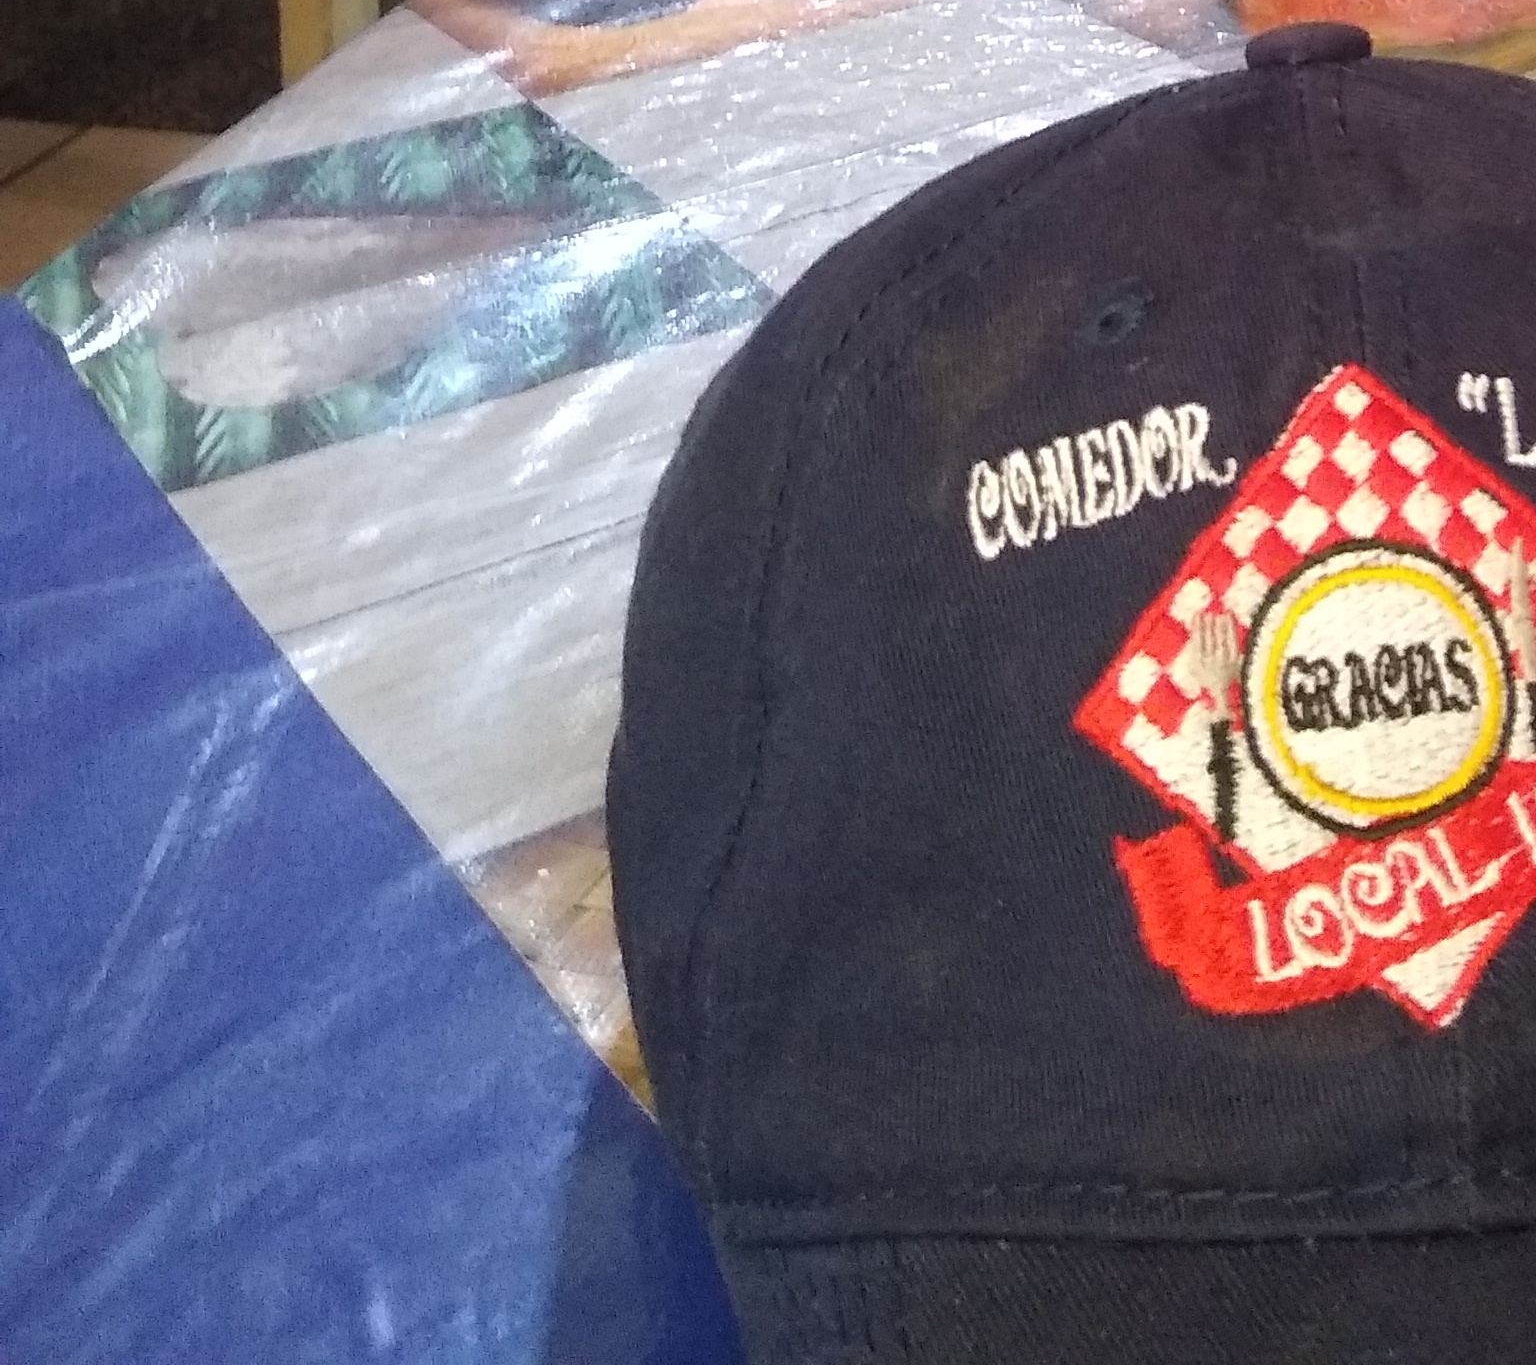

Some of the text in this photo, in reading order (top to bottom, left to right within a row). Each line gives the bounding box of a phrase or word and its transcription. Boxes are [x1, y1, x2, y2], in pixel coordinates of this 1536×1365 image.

[967, 403, 1236, 560] COMEDOR
[1281, 639, 1480, 734] GRACIAS
[1248, 825, 1510, 984] LOCAL
